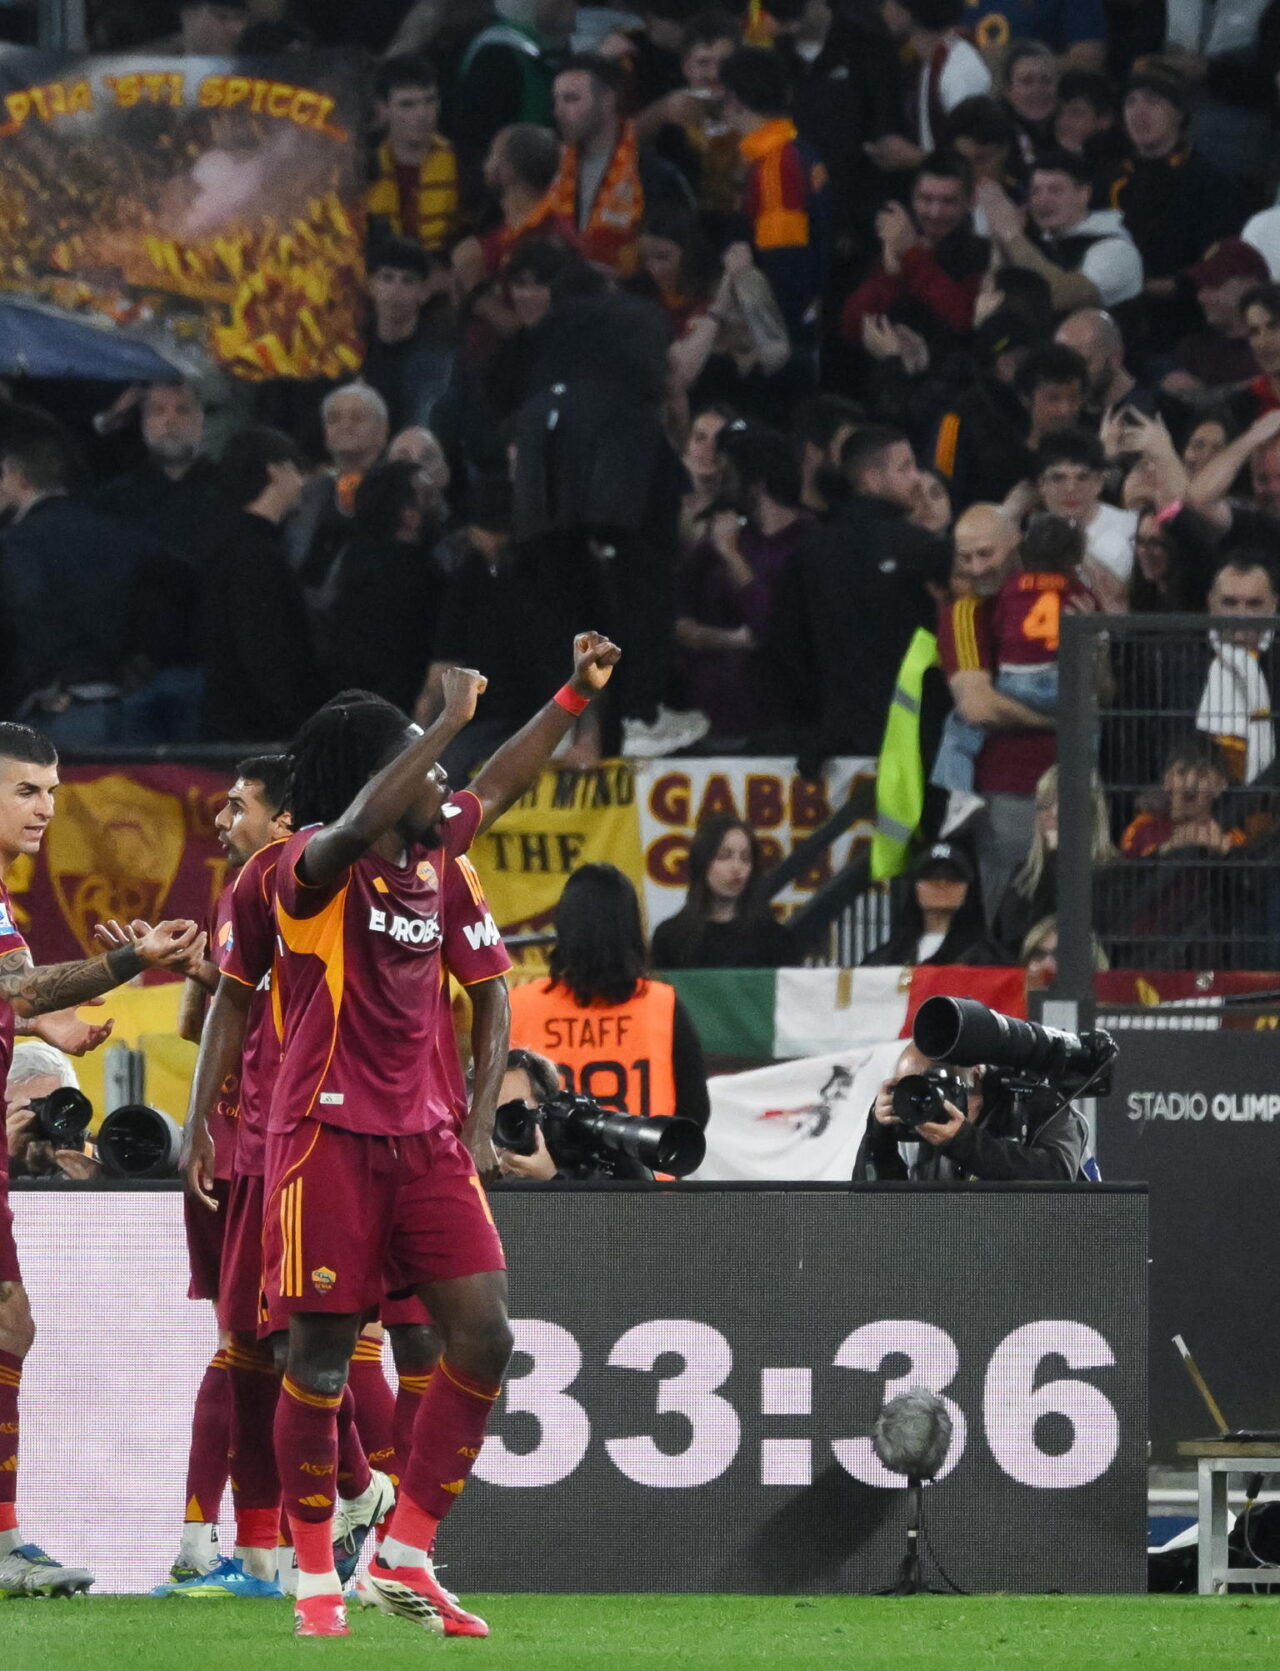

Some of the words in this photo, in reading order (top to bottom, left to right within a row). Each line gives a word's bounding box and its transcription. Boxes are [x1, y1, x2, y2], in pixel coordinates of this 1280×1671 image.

[1023, 589, 1060, 651] 4
[544, 1014, 633, 1049] STAFF
[1126, 1091, 1209, 1122] STADIO
[472, 1318, 1121, 1489] 33:36
